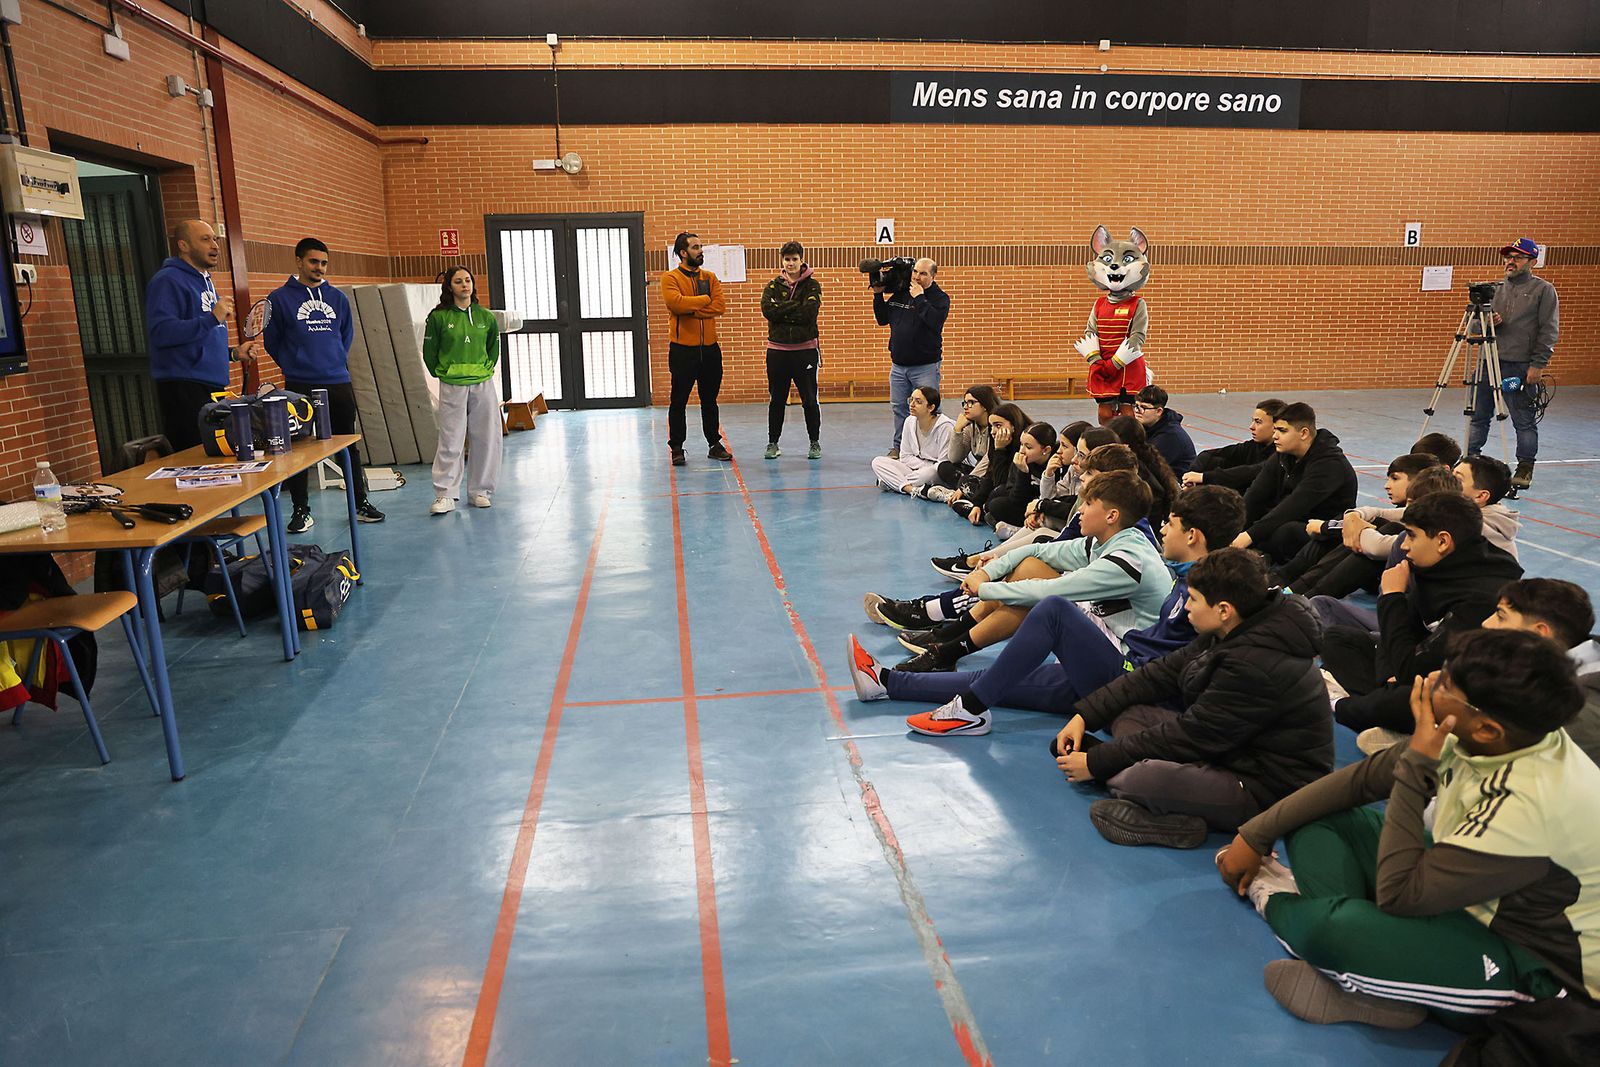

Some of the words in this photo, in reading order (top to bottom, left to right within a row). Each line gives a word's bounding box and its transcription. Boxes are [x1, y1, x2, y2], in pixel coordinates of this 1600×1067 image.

[912, 81, 988, 108] Mens
[996, 88, 1063, 109] sana
[1071, 84, 1097, 110] in
[1105, 90, 1210, 116] corpore
[1216, 92, 1282, 113] sano
[878, 226, 892, 243] A
[1407, 230, 1418, 245] B
